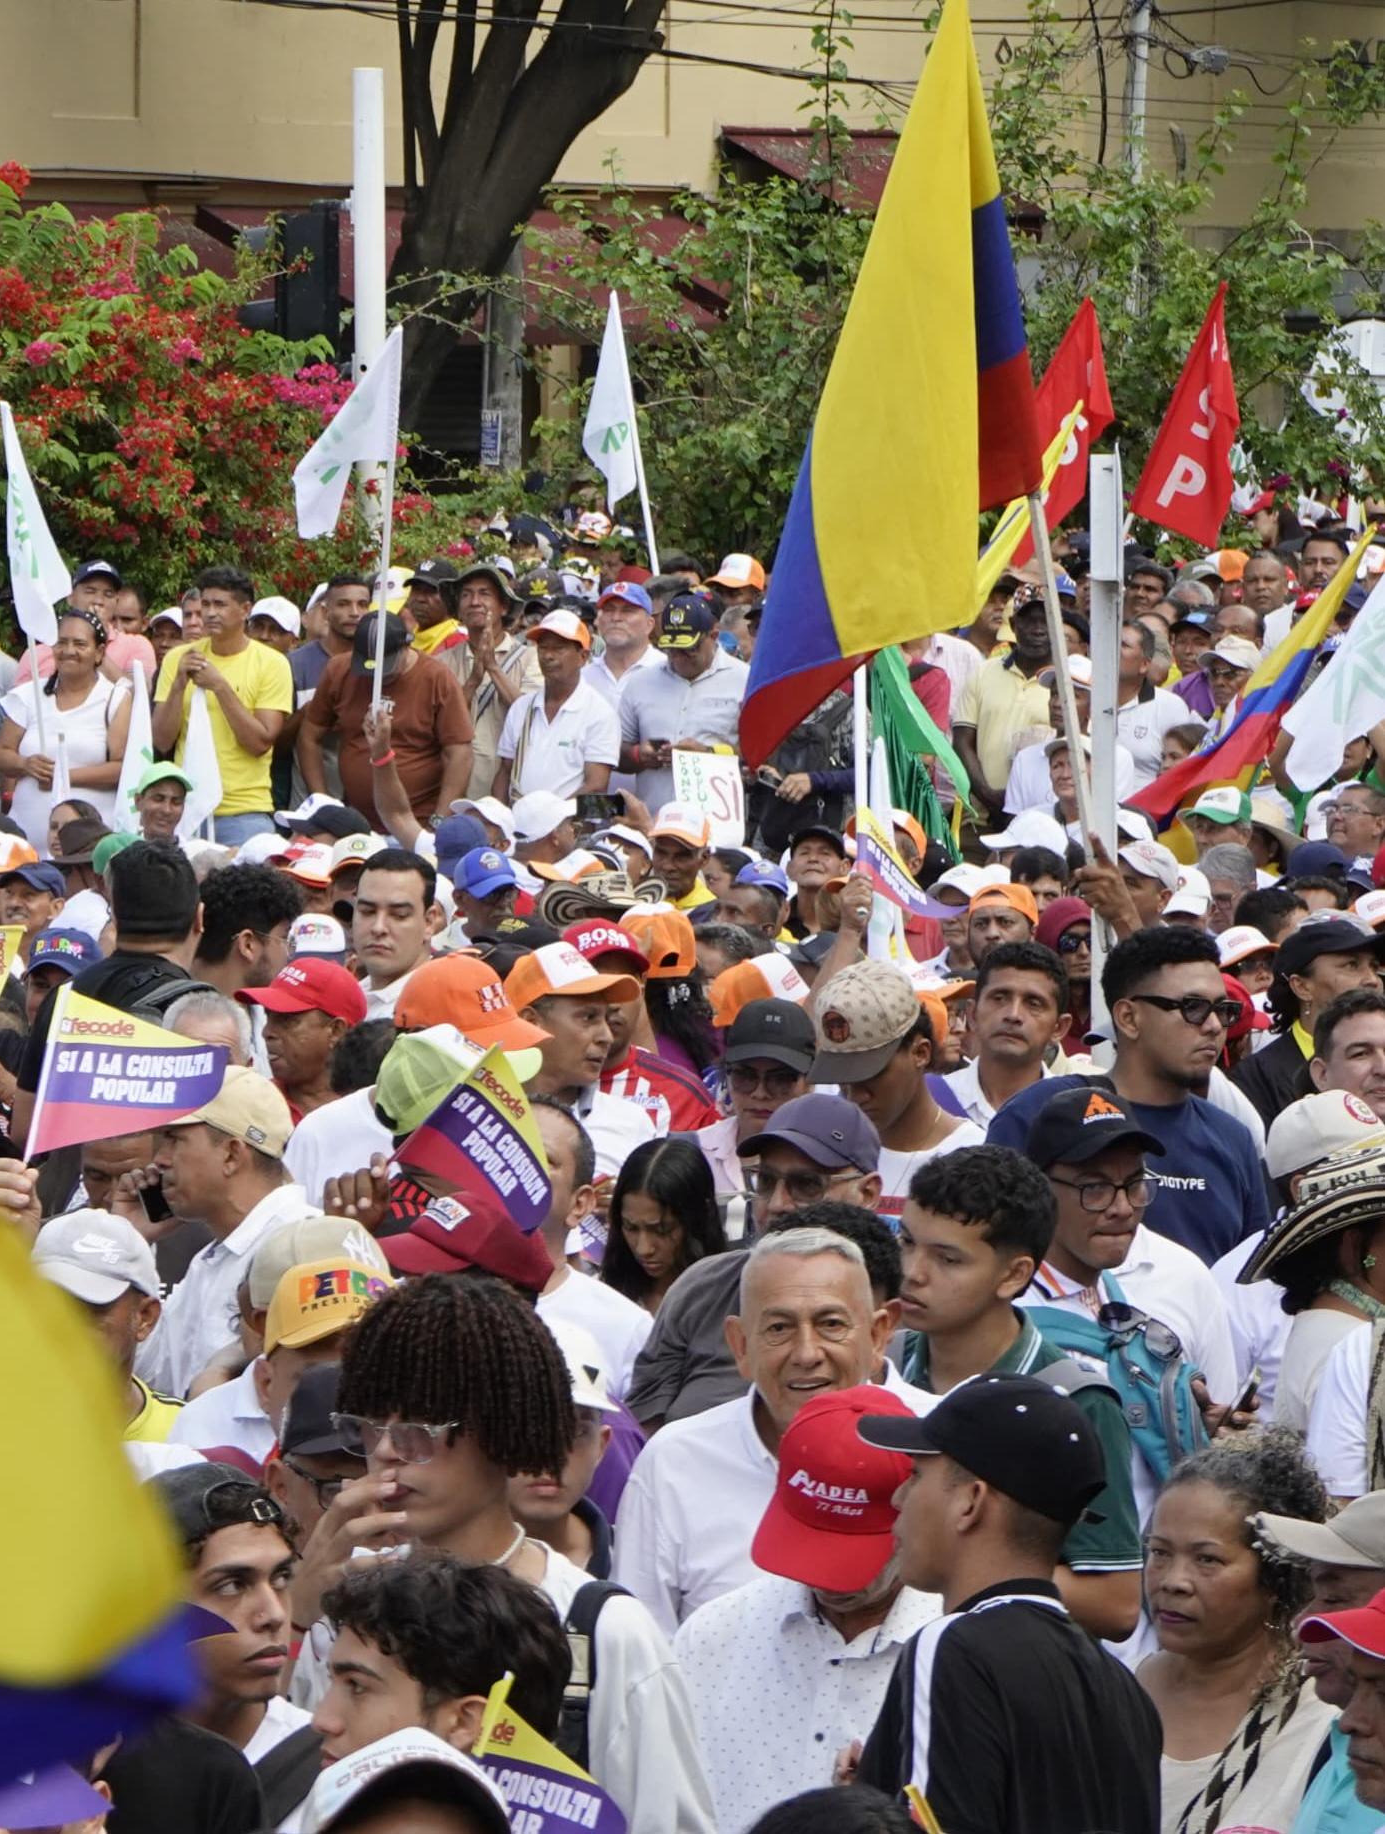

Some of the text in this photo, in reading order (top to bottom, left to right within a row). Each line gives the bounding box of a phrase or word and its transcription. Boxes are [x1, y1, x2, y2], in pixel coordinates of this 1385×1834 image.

[72, 1017, 135, 1036] fecode
[56, 1050, 214, 1078] SI A LA CONSULTA
[90, 1077, 177, 1104] POPULAR
[482, 1068, 526, 1120] fecode
[451, 1092, 549, 1206] SI A LA CONSULTA
[461, 1130, 519, 1198] POPULAR
[83, 1232, 118, 1249] NIKE
[496, 1766, 602, 1830] CONSULTA
